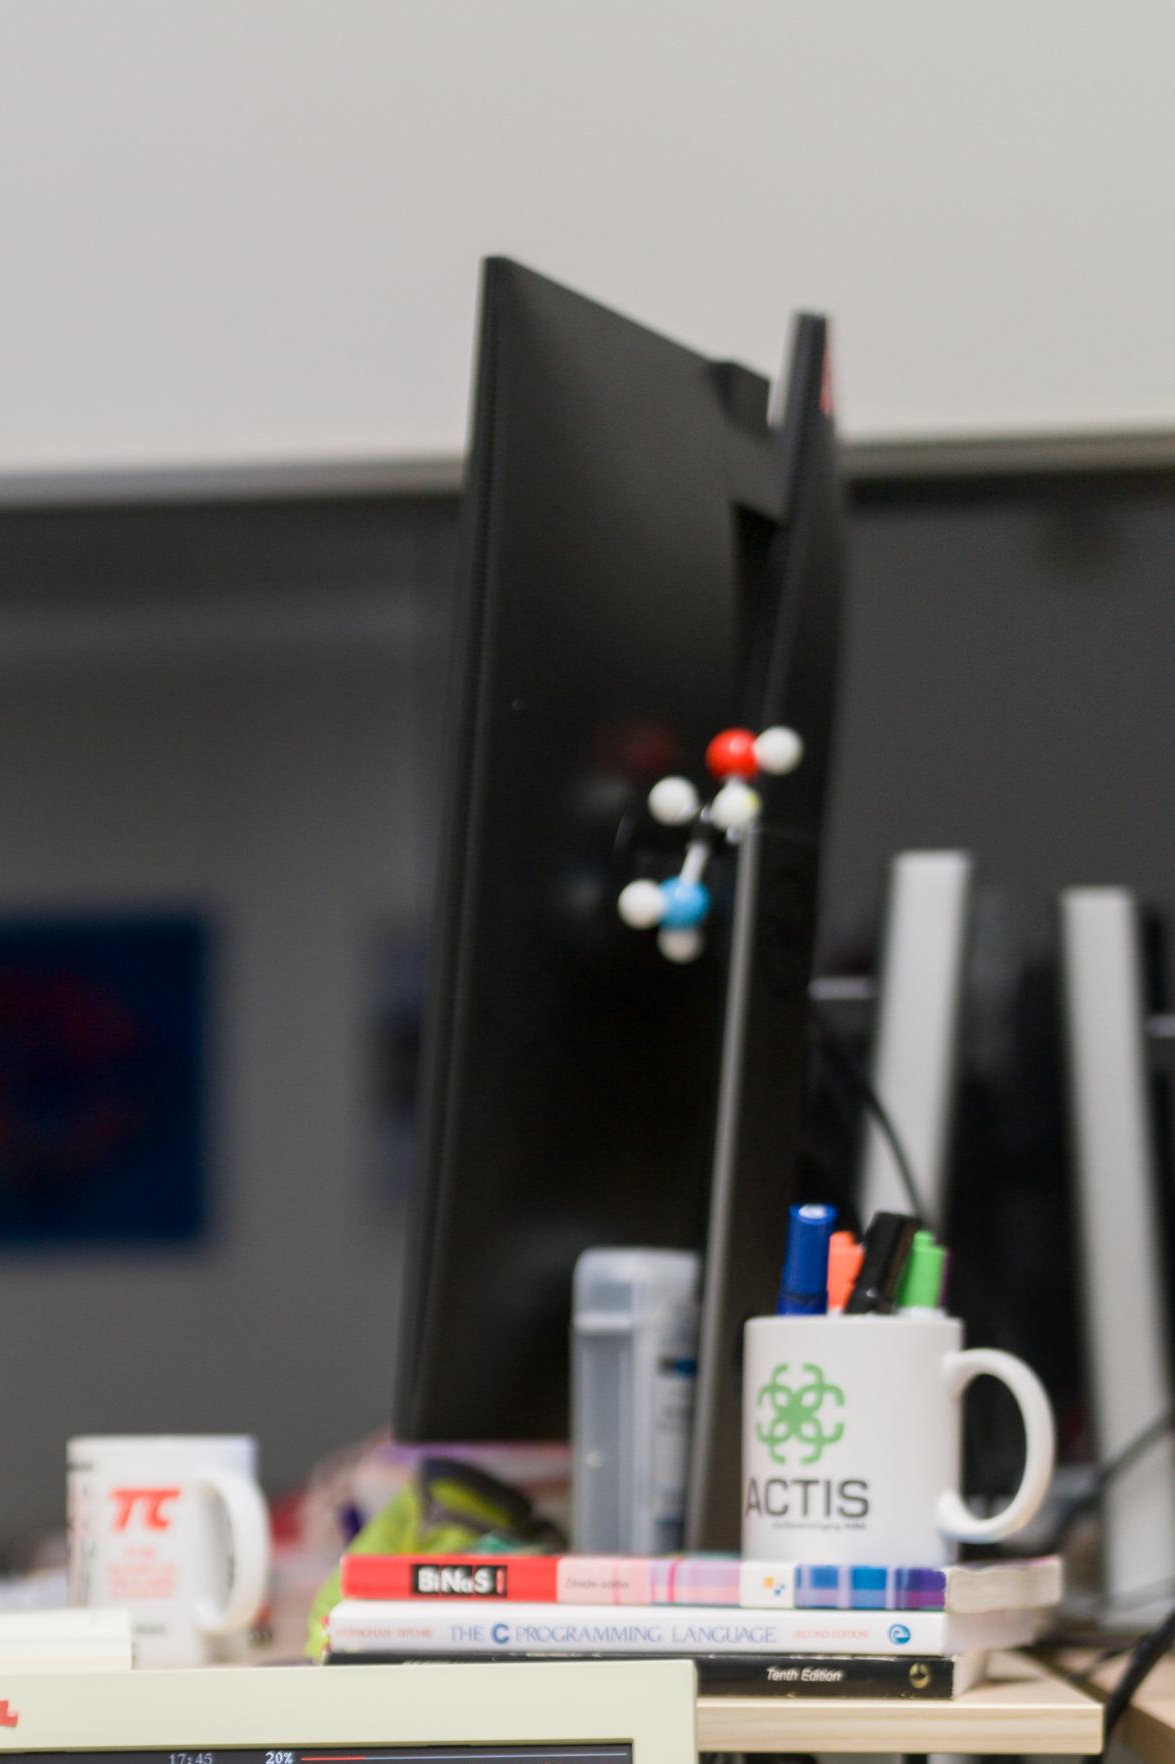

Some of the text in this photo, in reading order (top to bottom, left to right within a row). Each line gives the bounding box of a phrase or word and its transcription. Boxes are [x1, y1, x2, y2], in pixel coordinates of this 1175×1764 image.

[745, 1477, 869, 1518] ACTIS
[449, 1623, 776, 1645] THE C PROGRAMMING LANGUAGE
[767, 1666, 843, 1682] Tenth Edition
[265, 1752, 293, 1764] 20%
